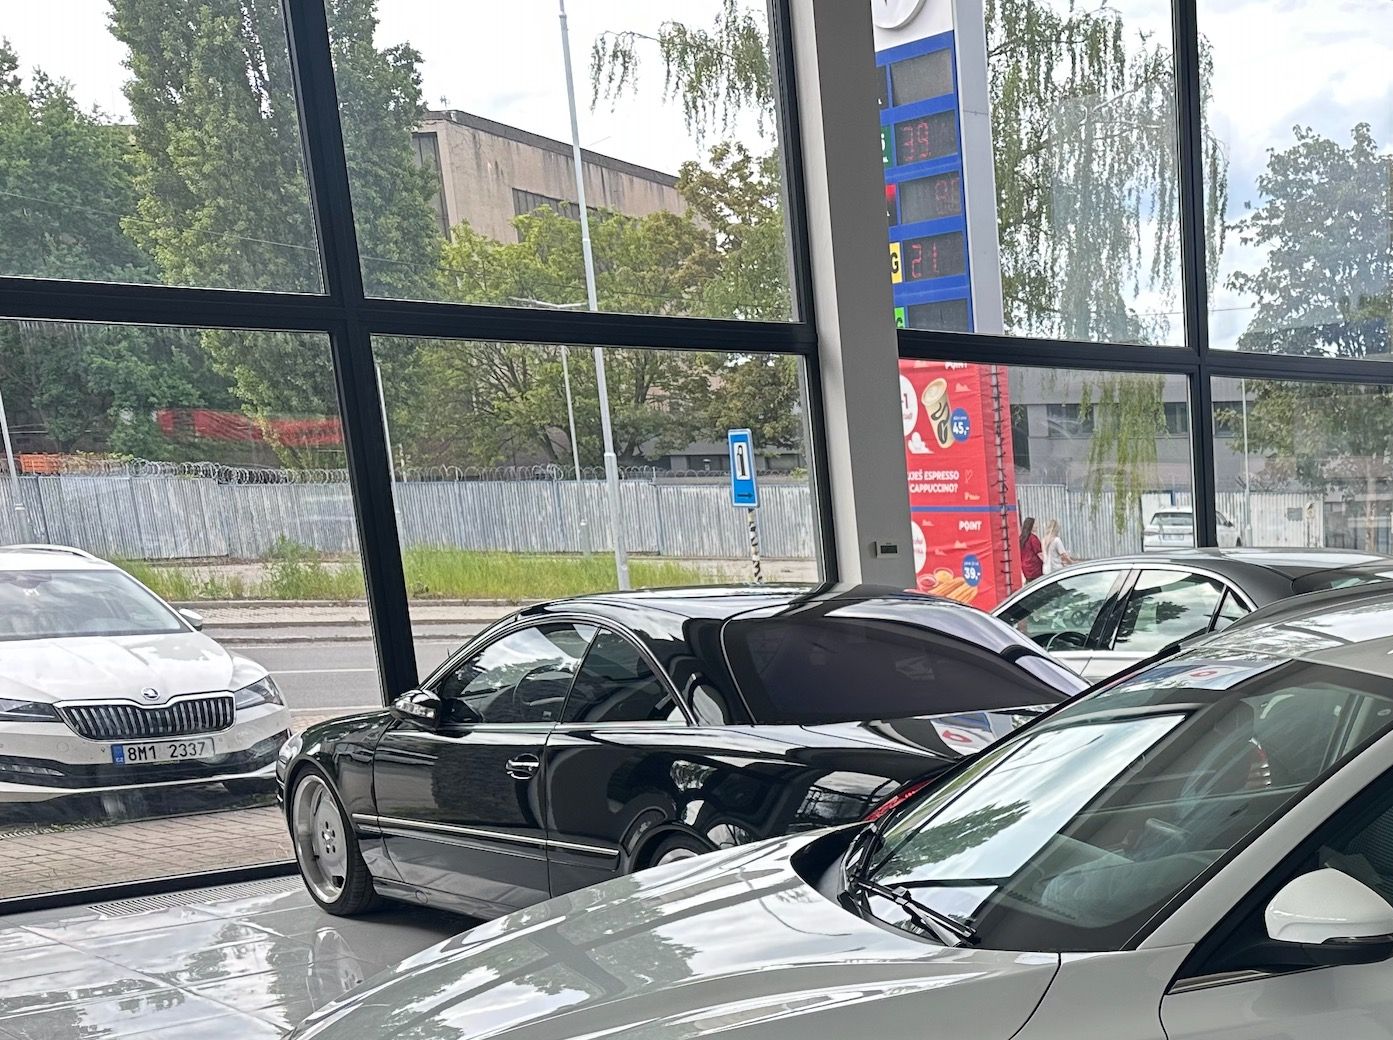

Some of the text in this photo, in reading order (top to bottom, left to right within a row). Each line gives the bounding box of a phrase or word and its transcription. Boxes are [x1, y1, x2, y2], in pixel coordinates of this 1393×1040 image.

[924, 470, 960, 481] ESPRESSO
[909, 482, 959, 493] CAPPUCCINO?
[958, 520, 982, 532] POINT
[127, 745, 157, 761] 8M1
[168, 741, 206, 758] 2337
